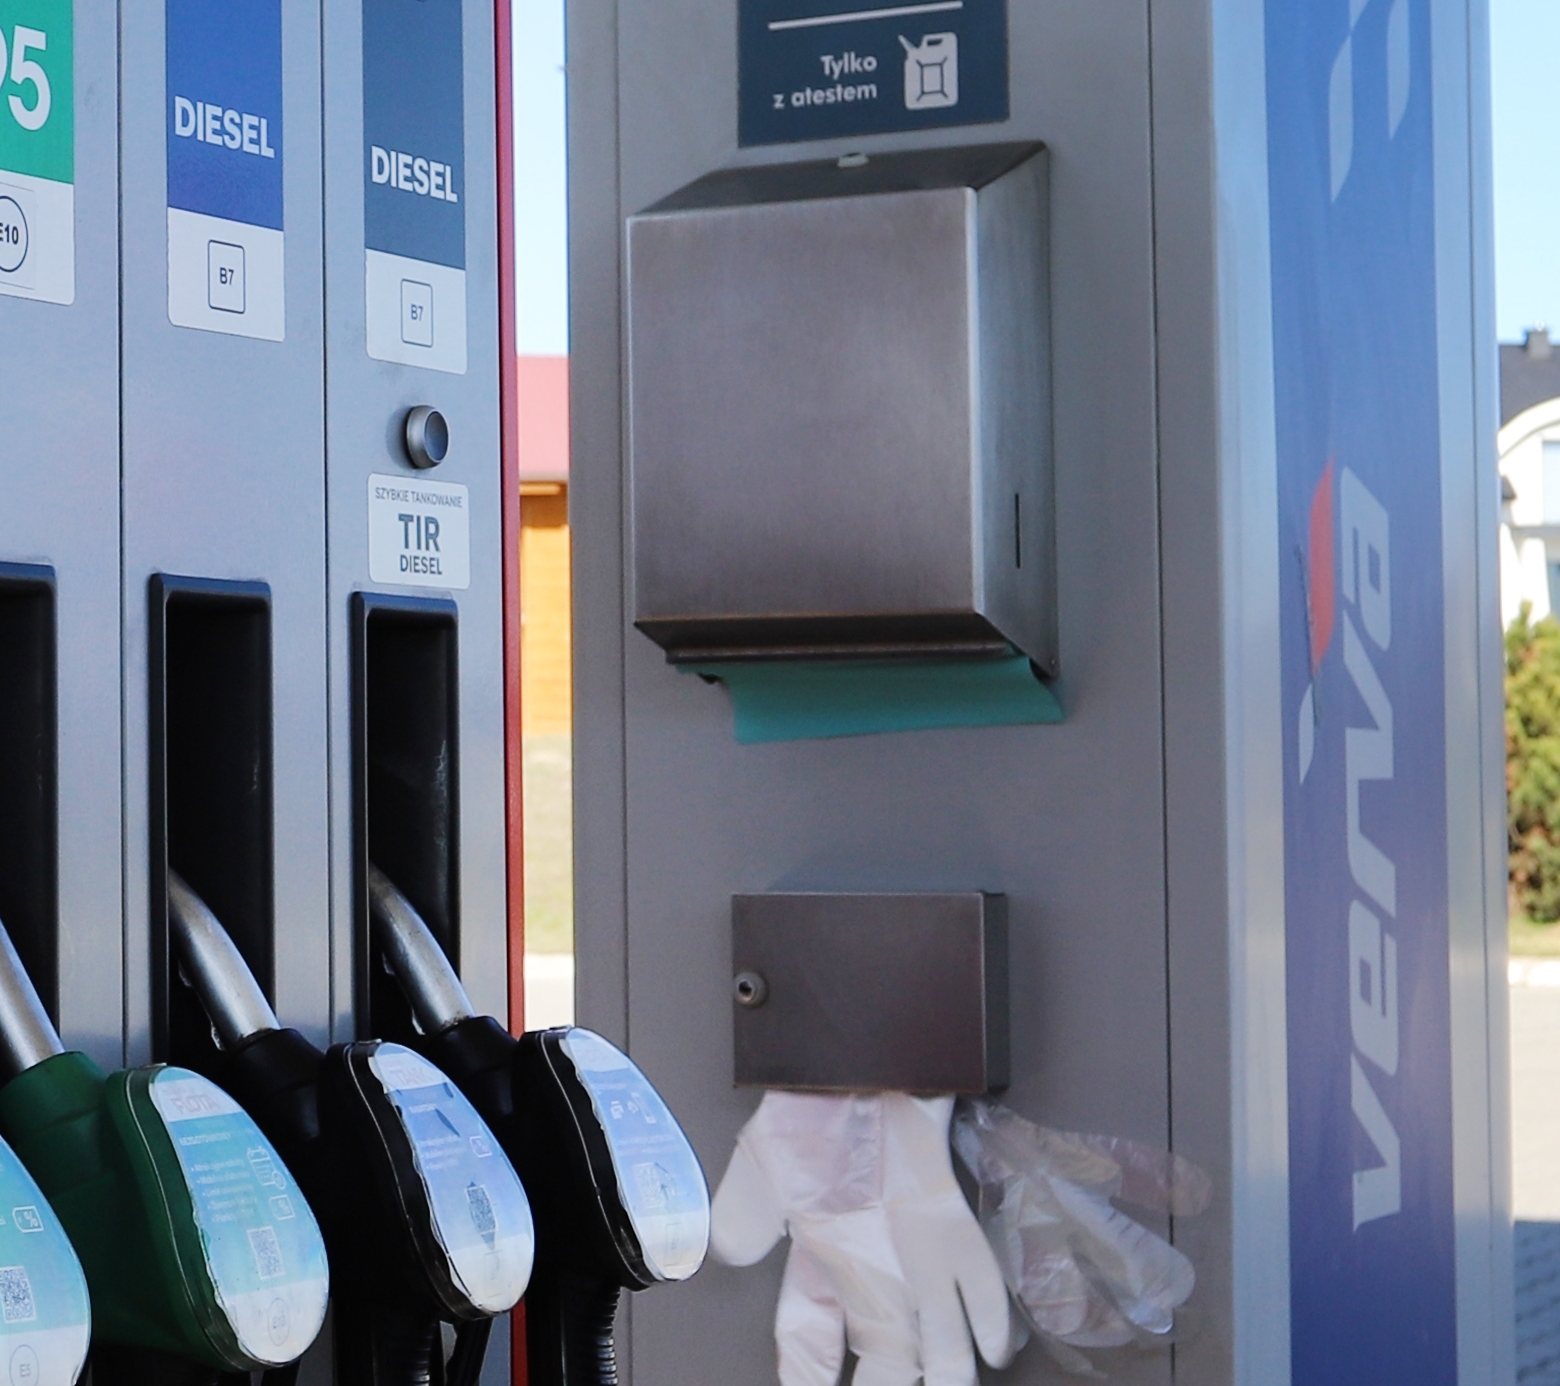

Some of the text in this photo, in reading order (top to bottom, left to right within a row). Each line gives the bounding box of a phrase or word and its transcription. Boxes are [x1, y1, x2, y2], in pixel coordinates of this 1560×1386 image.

[821, 54, 878, 80] Tylko
[773, 82, 878, 109] z atestem
[175, 96, 274, 159] DIESEL
[371, 146, 458, 203] DIESEL
[219, 265, 234, 286] B7
[410, 303, 424, 322] B7
[375, 487, 463, 508] SZYBKIE TANKOWANIE
[398, 513, 441, 552] TIR
[400, 554, 442, 575] DIESEL
[1341, 465, 1401, 1233] verva
[20, 1363, 31, 1378] E5
